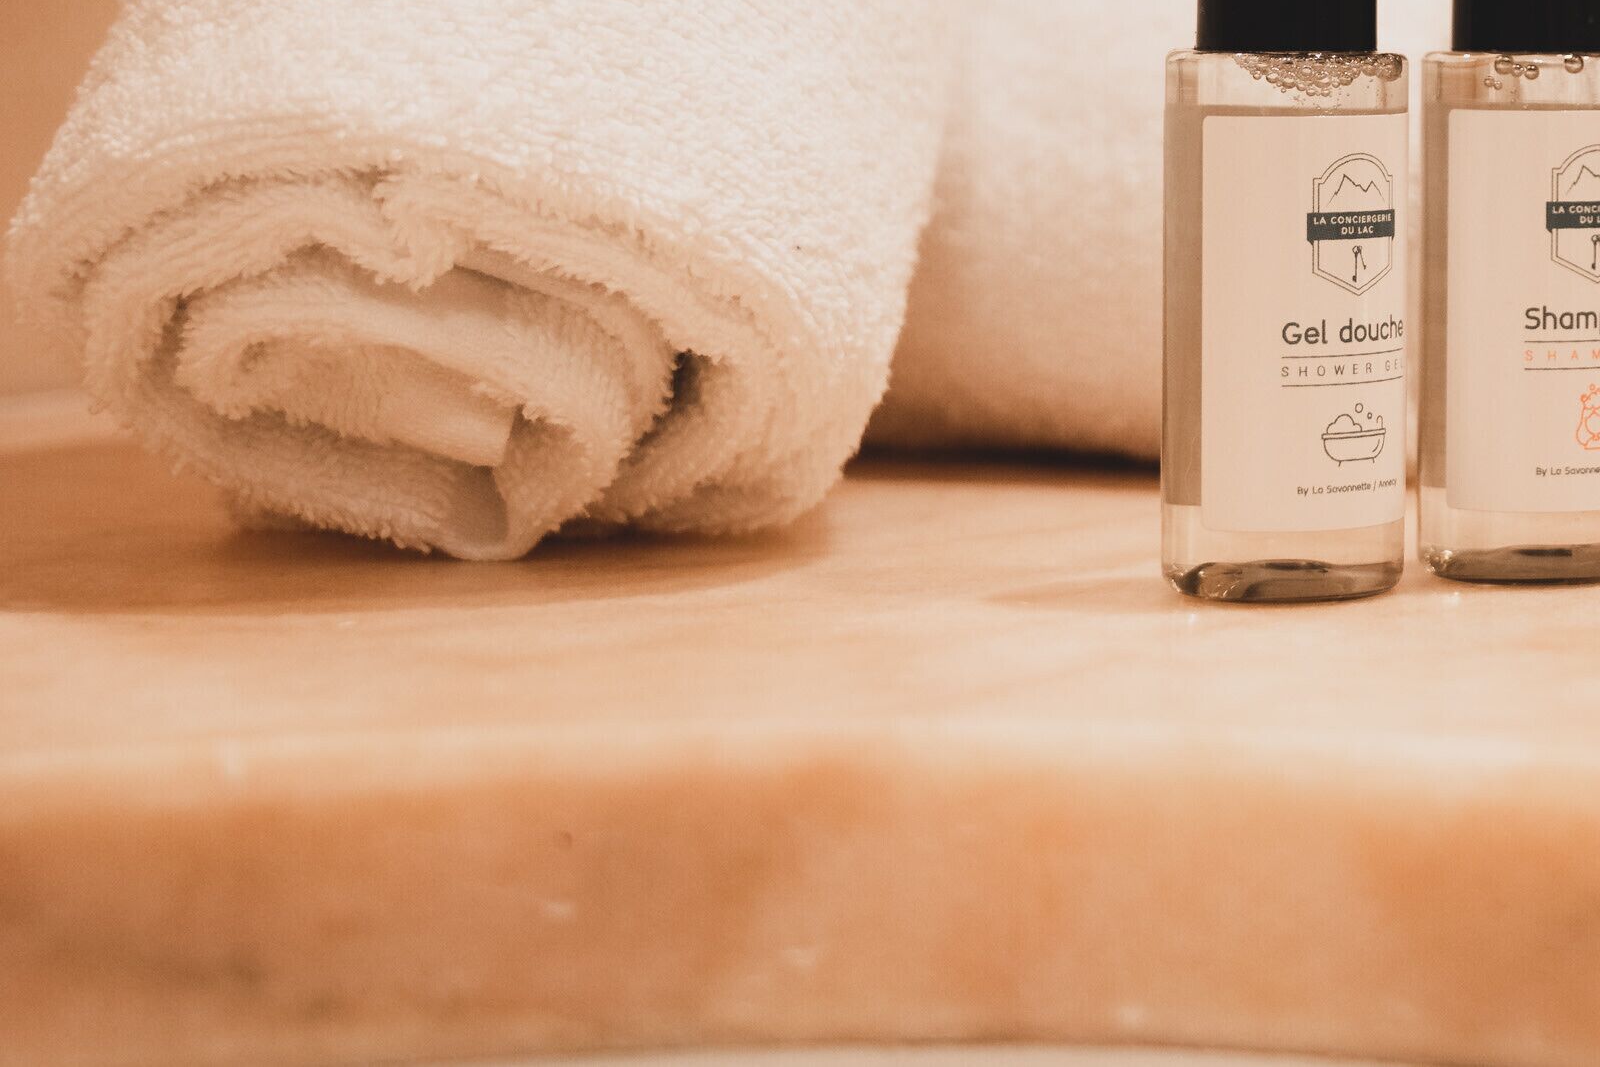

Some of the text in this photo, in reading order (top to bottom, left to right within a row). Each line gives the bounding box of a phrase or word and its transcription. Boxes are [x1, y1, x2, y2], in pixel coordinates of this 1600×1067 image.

[1551, 205, 1565, 214] LA
[1313, 213, 1392, 225] LA CONCIERGERIE
[1579, 215, 1594, 224] DU
[1341, 225, 1374, 235] DU LAC
[1281, 314, 1403, 345] Gel douche
[1281, 361, 1372, 377] SHOWER
[1535, 466, 1548, 477] By
[1550, 466, 1562, 475] La
[1296, 486, 1309, 497] By
[1312, 486, 1323, 495] La
[1326, 482, 1371, 494] Savonnette
